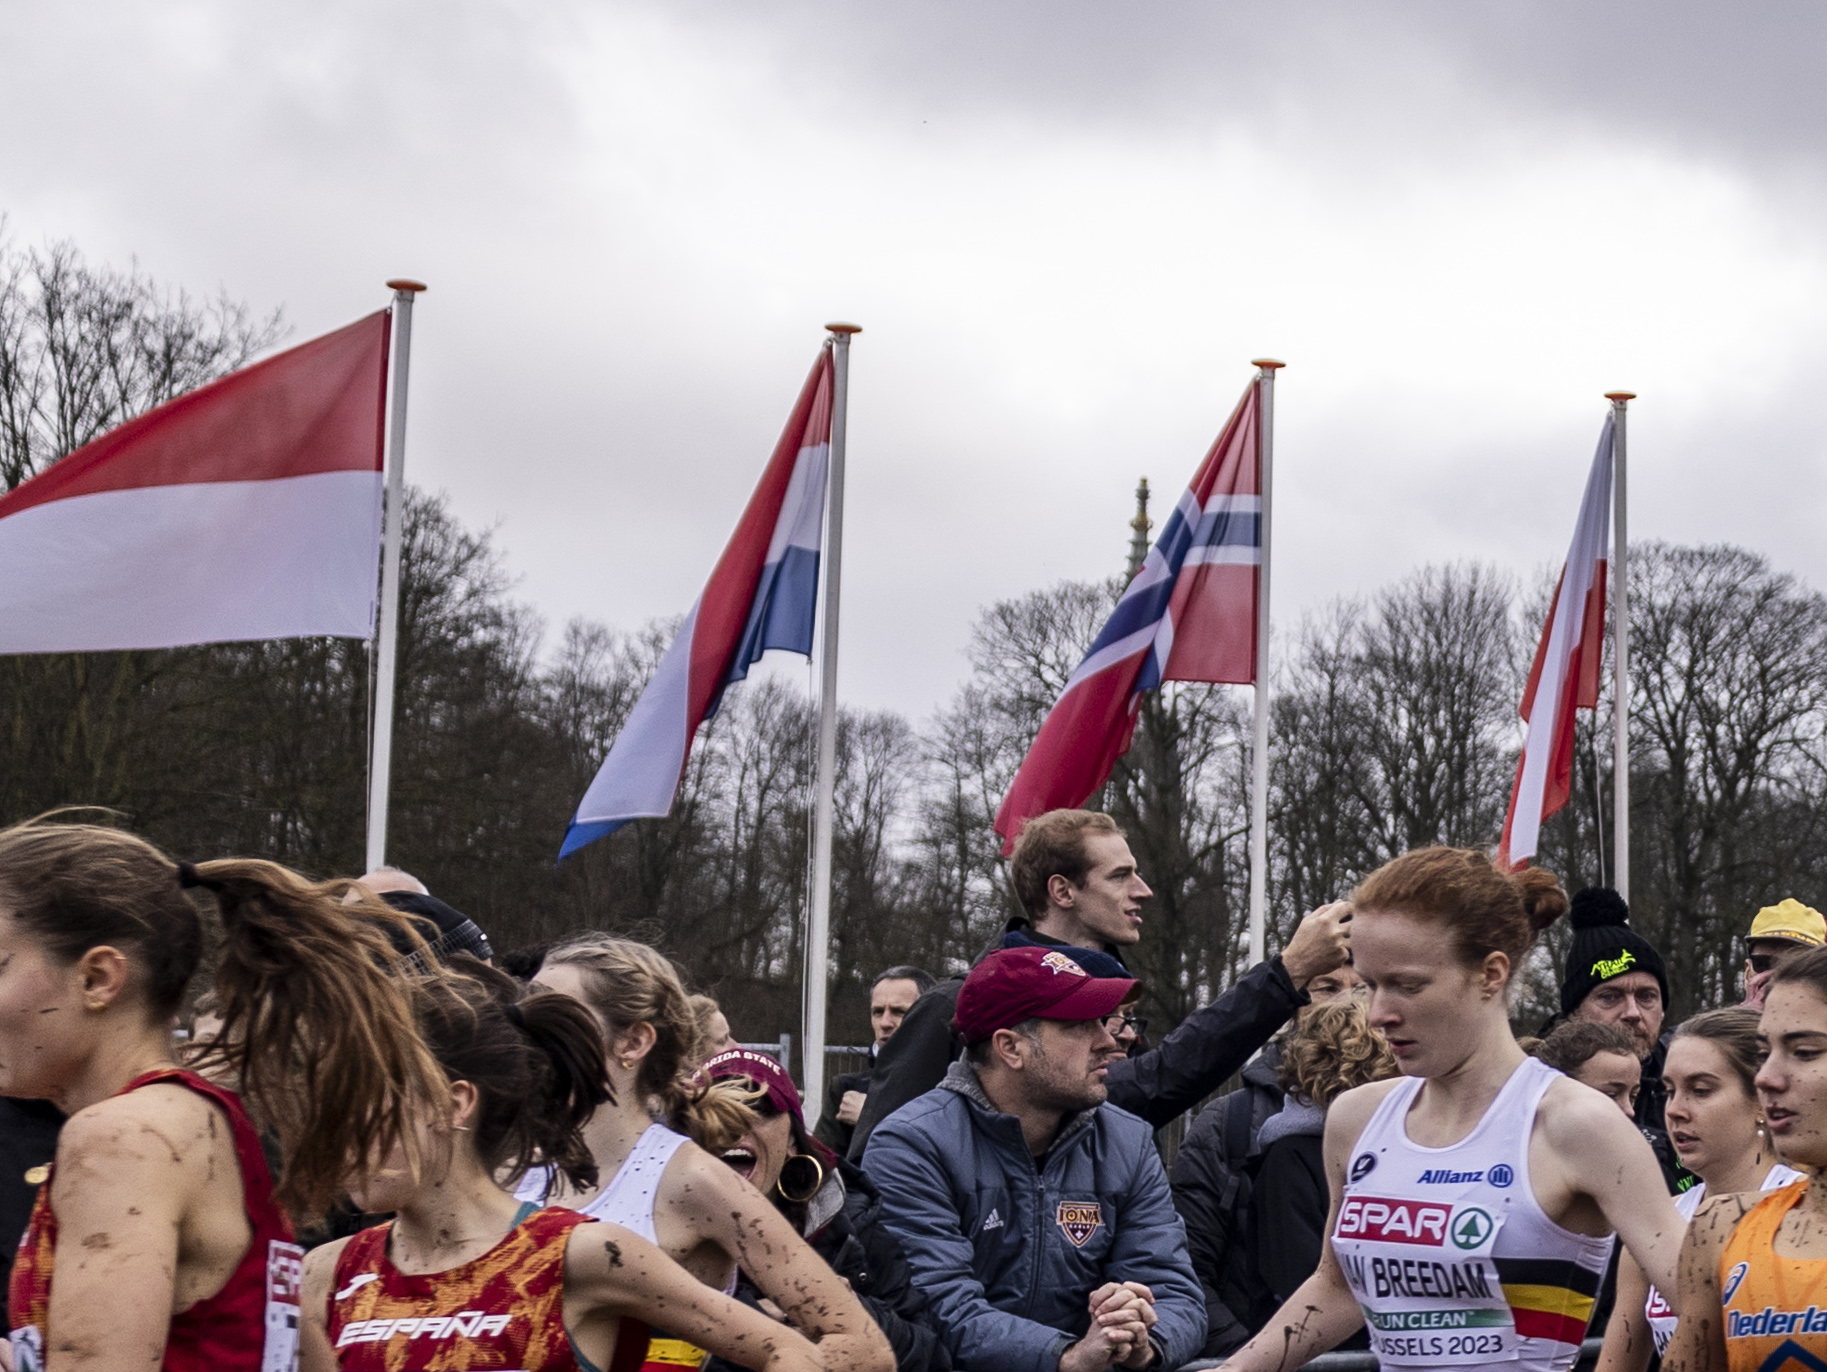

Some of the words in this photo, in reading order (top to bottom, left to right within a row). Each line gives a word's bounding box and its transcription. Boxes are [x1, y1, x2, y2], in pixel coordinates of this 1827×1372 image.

[743, 1051, 781, 1076] STATE
[1417, 1170, 1484, 1184] Allianz
[1059, 1209, 1100, 1223] IONA
[1340, 1202, 1447, 1240] SPAR
[1371, 1256, 1494, 1299] BREEDAM
[335, 1311, 513, 1348] ESPAÑA
[1448, 1335, 1504, 1355] 2023
